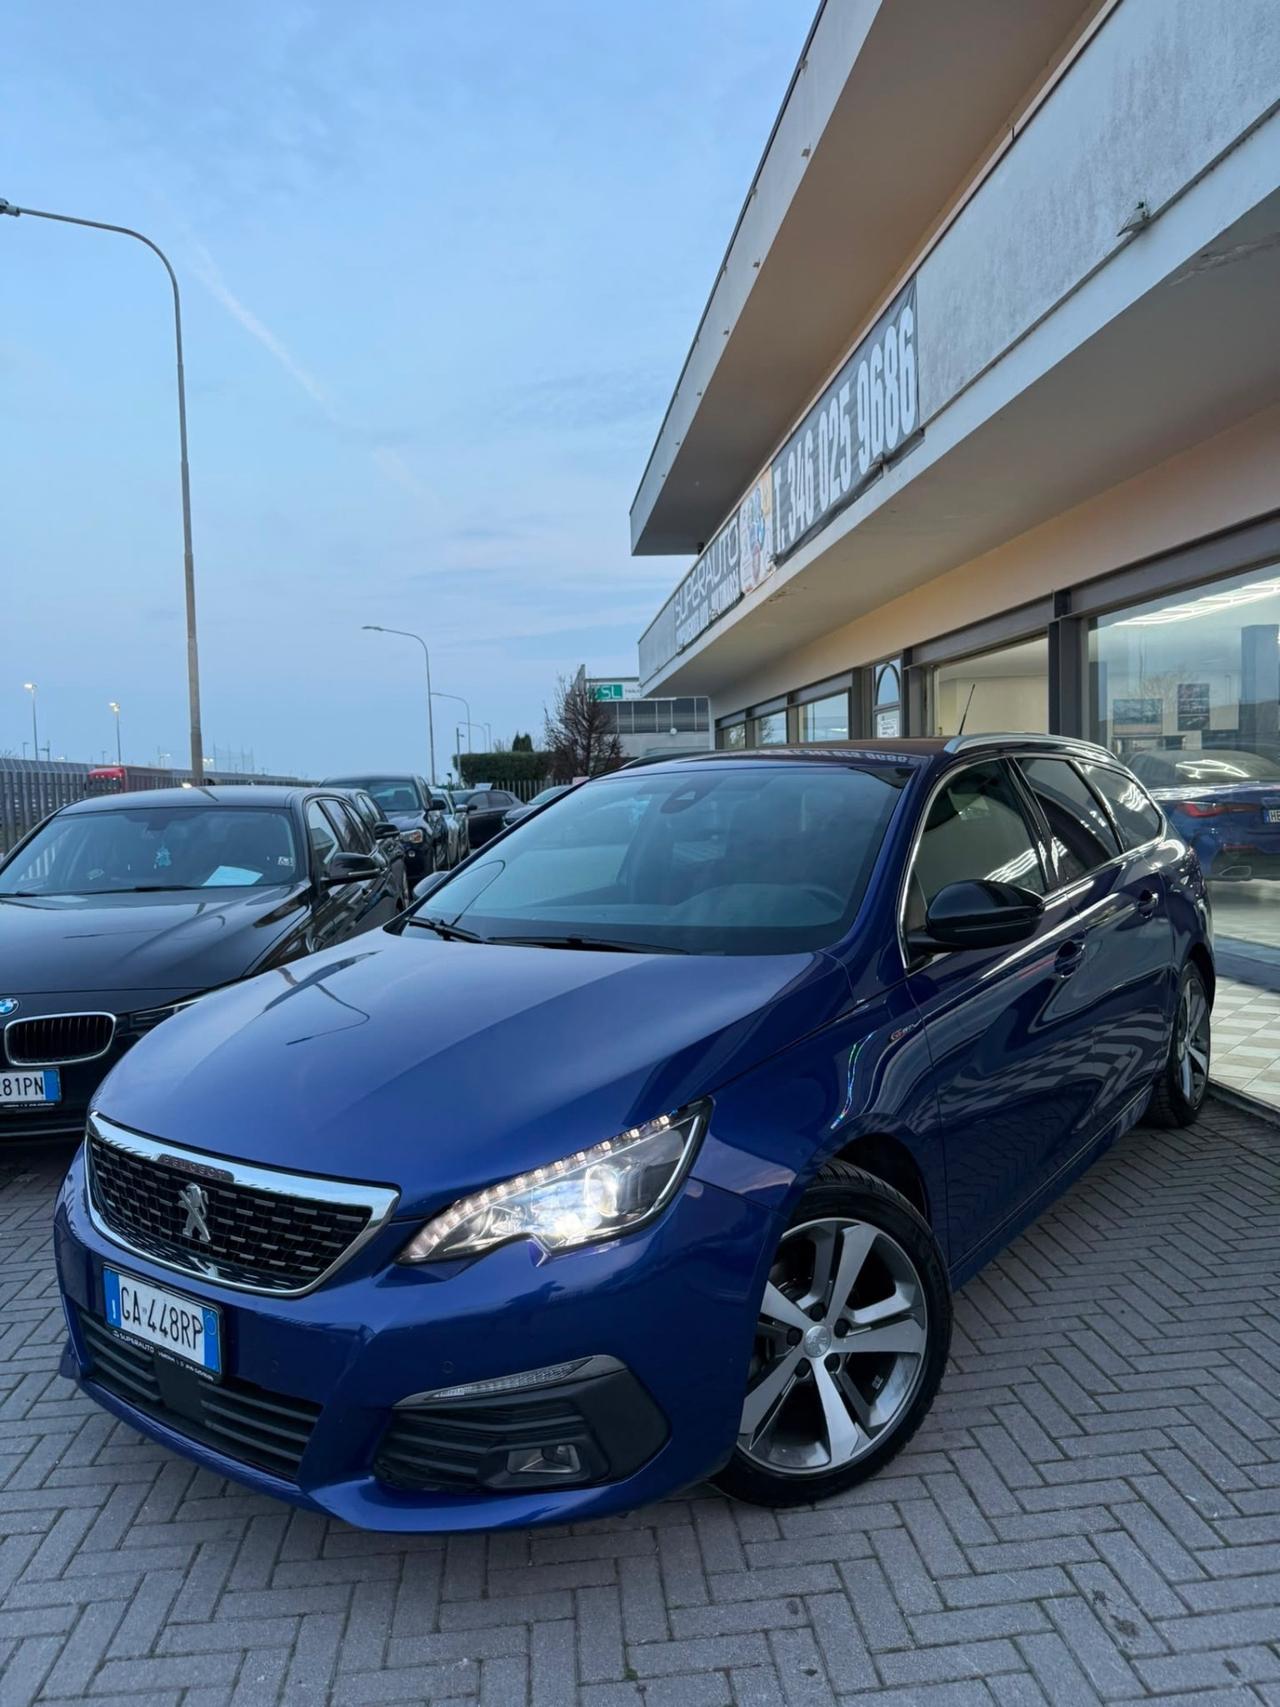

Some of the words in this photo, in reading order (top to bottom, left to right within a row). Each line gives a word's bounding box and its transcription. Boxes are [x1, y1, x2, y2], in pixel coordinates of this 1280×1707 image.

[818, 381, 851, 513] 025
[857, 305, 916, 475] 9686
[675, 517, 739, 627] SUPERAUTO
[0, 1077, 44, 1096] 81PN
